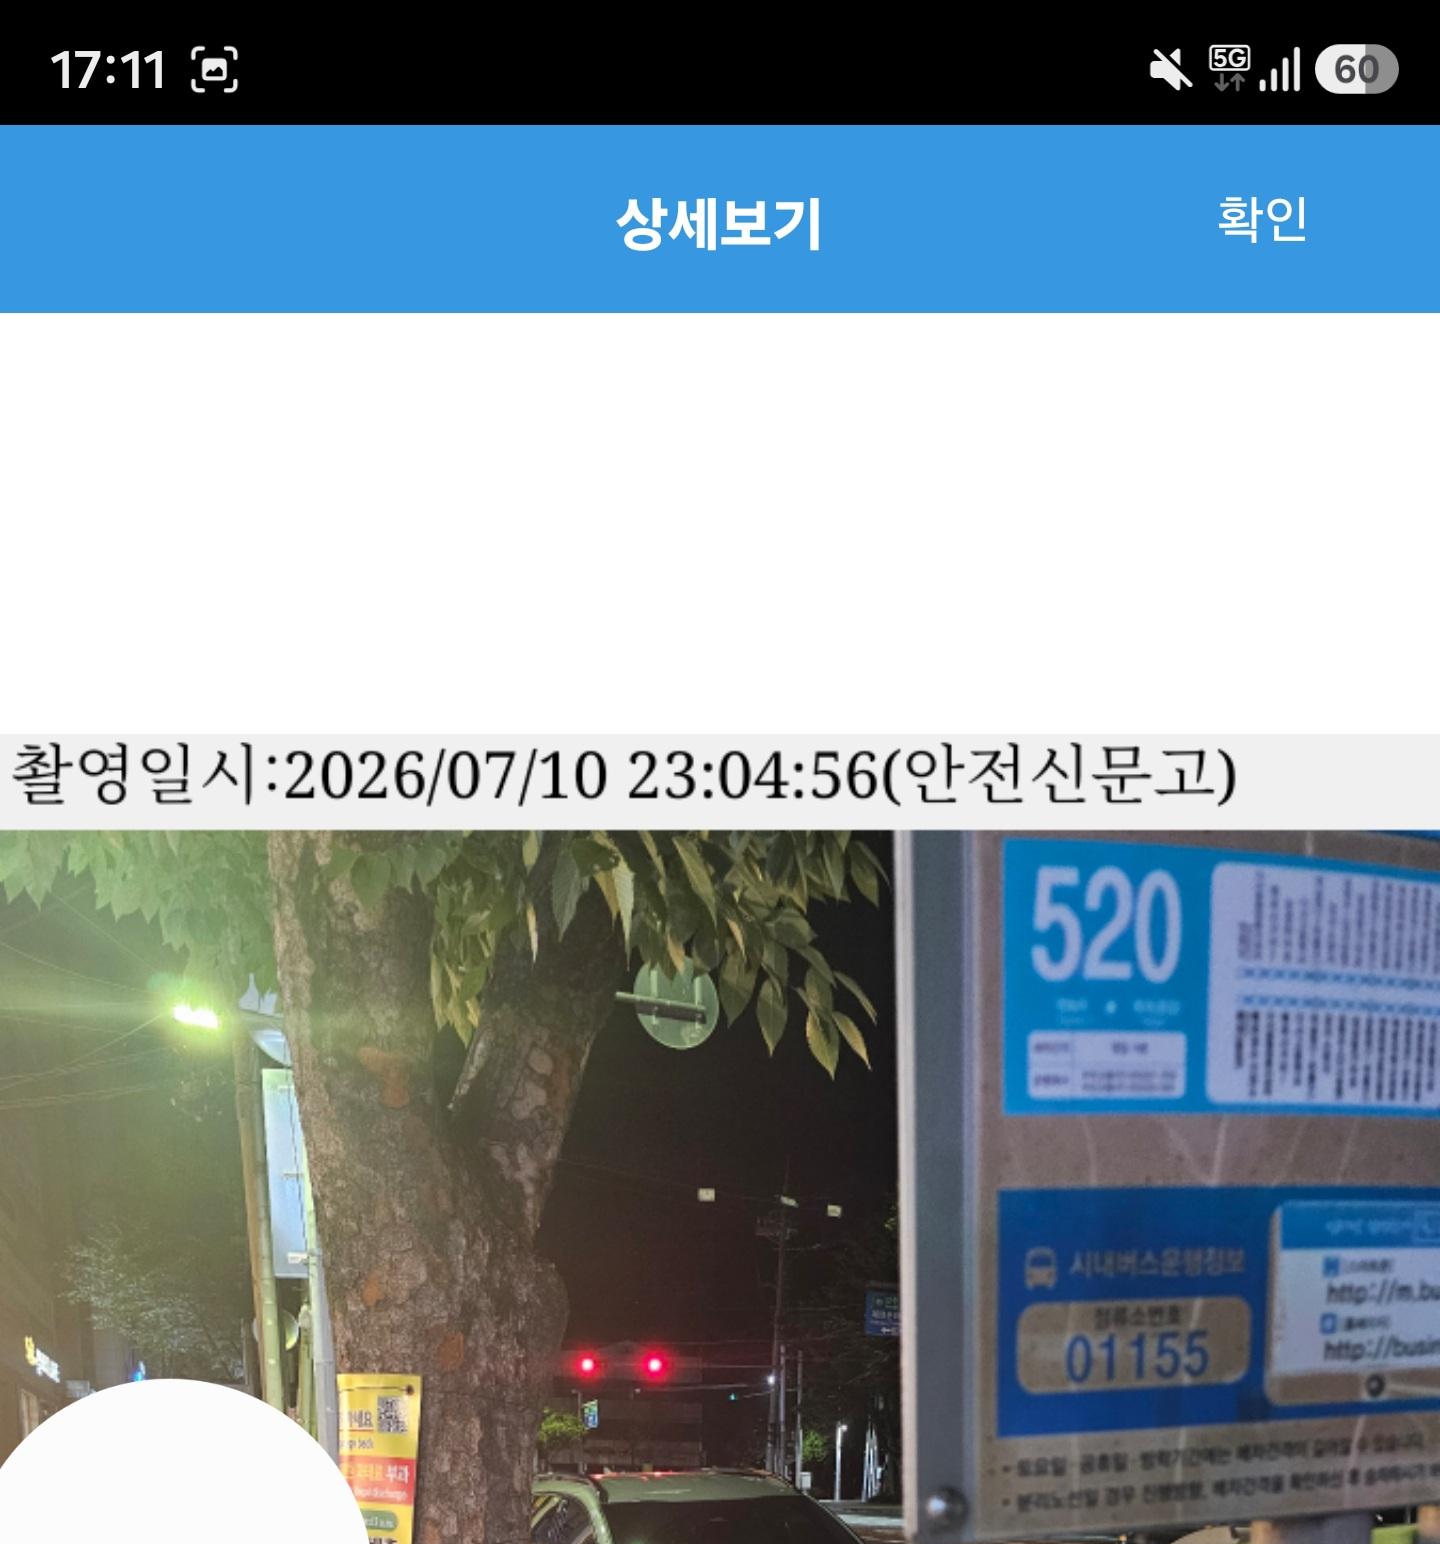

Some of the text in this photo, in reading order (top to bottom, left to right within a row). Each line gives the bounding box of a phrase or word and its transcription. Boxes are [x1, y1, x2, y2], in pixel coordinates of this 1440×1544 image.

[51, 50, 164, 89] 17:11
[1213, 48, 1247, 67] 5G
[1335, 54, 1379, 84] 60
[616, 197, 821, 252] 상세보기
[1218, 195, 1308, 244] 확인
[1031, 865, 1182, 984] 520
[1070, 1246, 1245, 1278] 시내버스운행정보
[1095, 1305, 1182, 1330] 정류소번호
[1066, 1328, 1210, 1383] 01155
